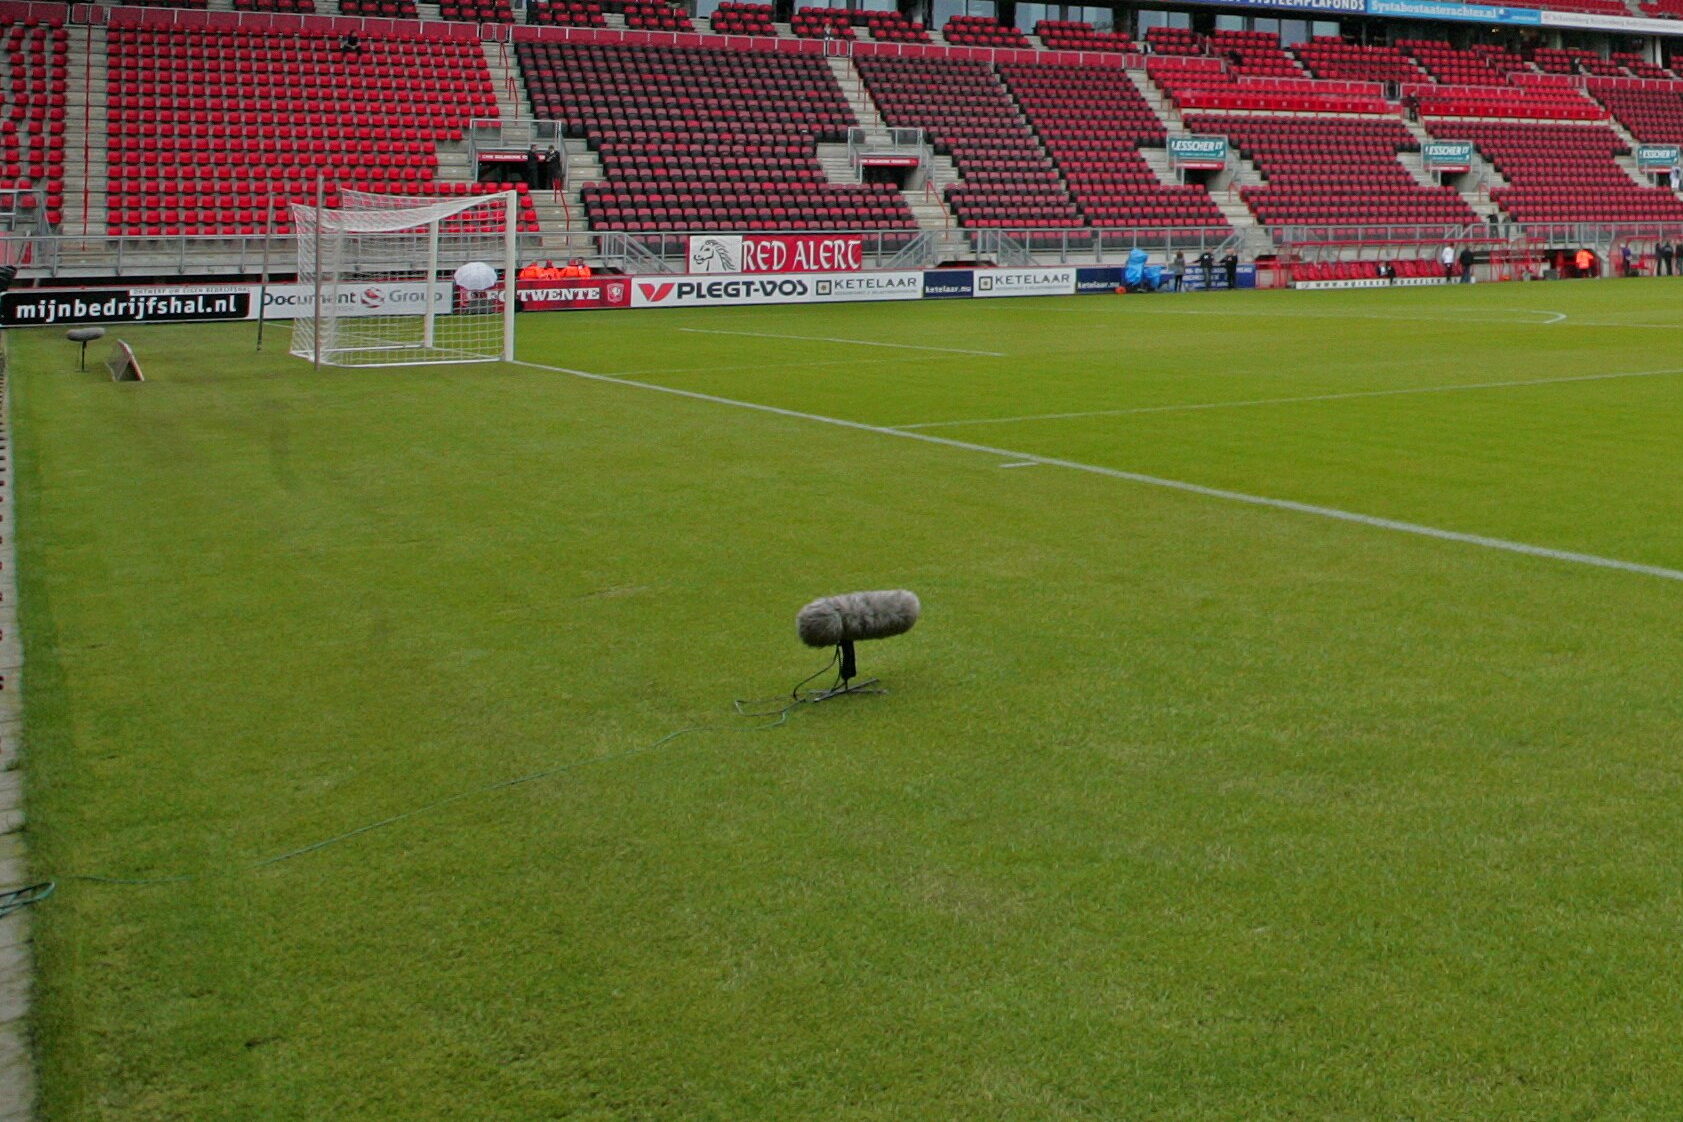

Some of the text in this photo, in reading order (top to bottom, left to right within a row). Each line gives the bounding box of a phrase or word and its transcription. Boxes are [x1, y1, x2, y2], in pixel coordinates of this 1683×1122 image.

[742, 239, 862, 271] RED ALERT
[677, 279, 809, 299] PLEGT-VOS
[834, 278, 917, 290] KETELAAR
[995, 273, 1070, 286] KETELAAR
[517, 287, 600, 302] TWENTE
[15, 294, 237, 323] mijnbedrijfshal.nl
